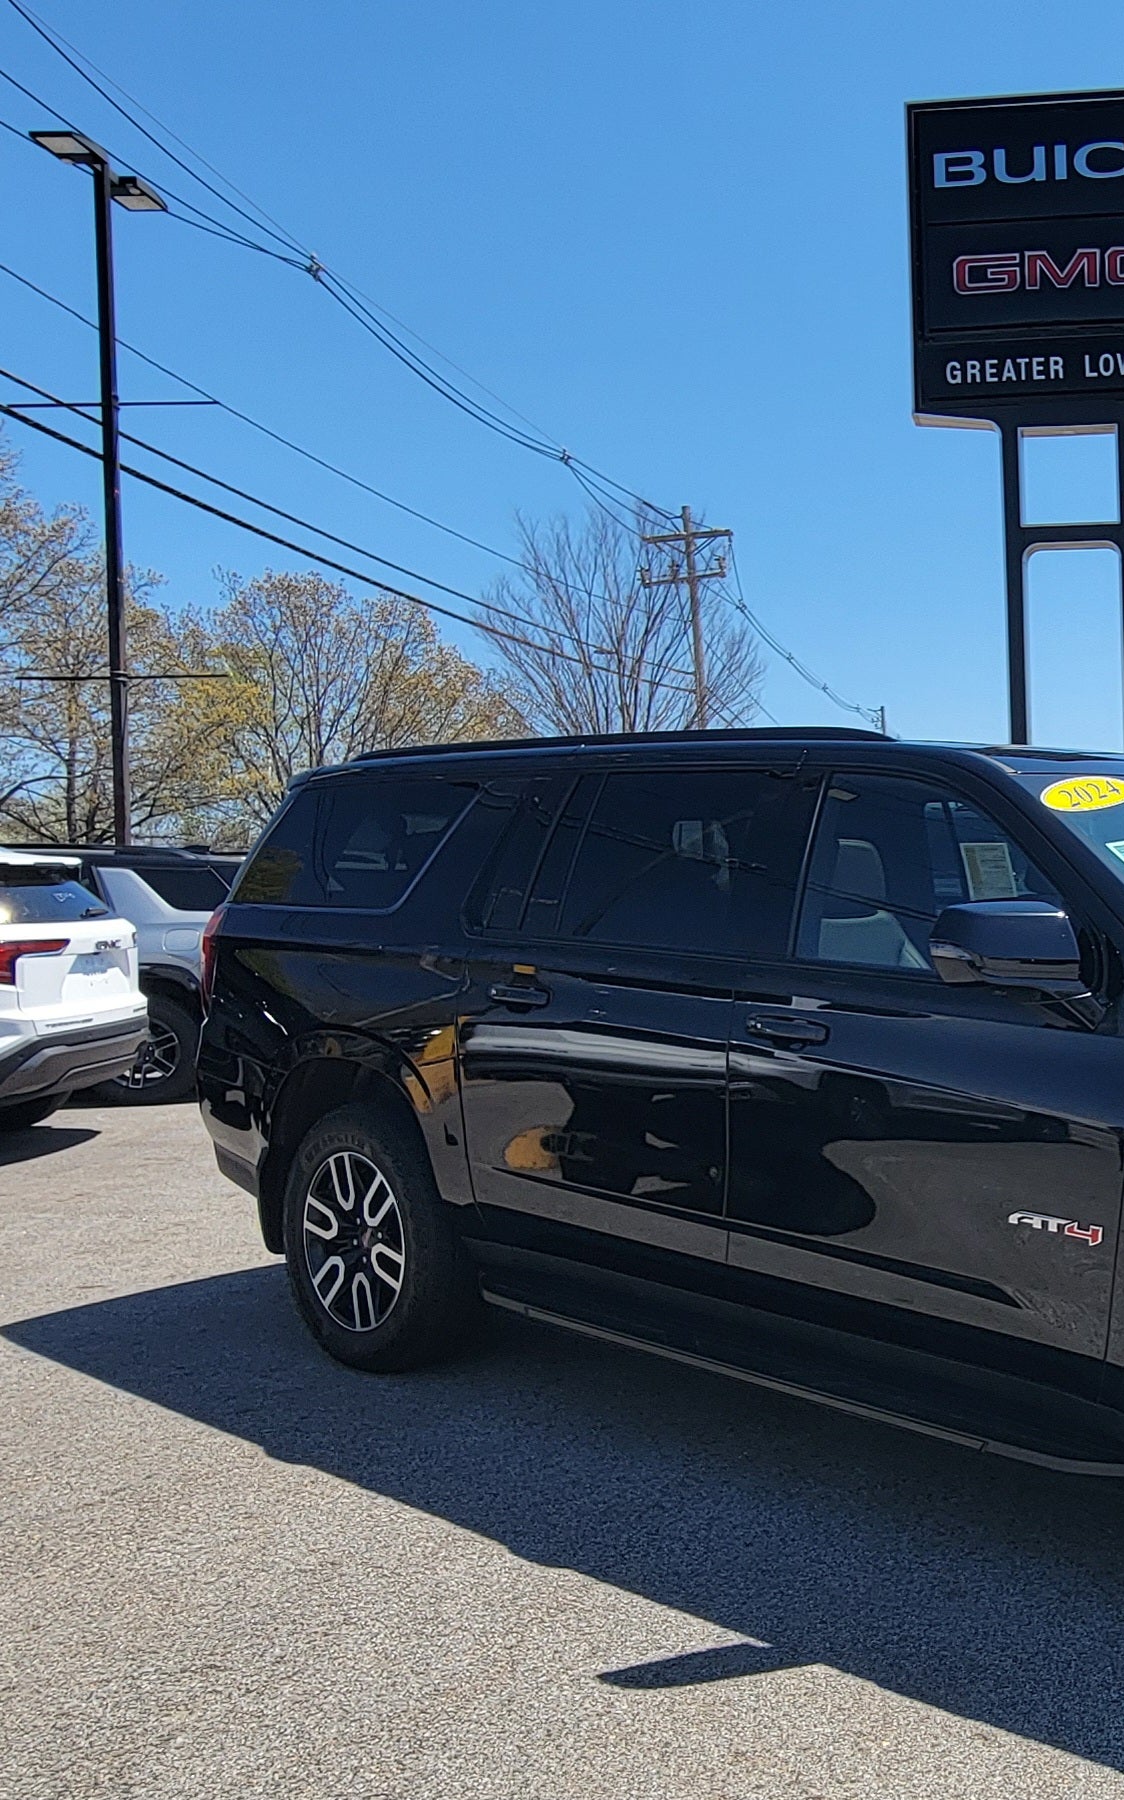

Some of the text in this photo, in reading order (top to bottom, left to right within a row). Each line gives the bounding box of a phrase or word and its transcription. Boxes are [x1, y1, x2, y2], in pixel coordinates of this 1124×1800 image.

[945, 356, 1064, 384] GREATER
[1058, 780, 1120, 807] 2024
[1008, 1210, 1103, 1246] AT4
